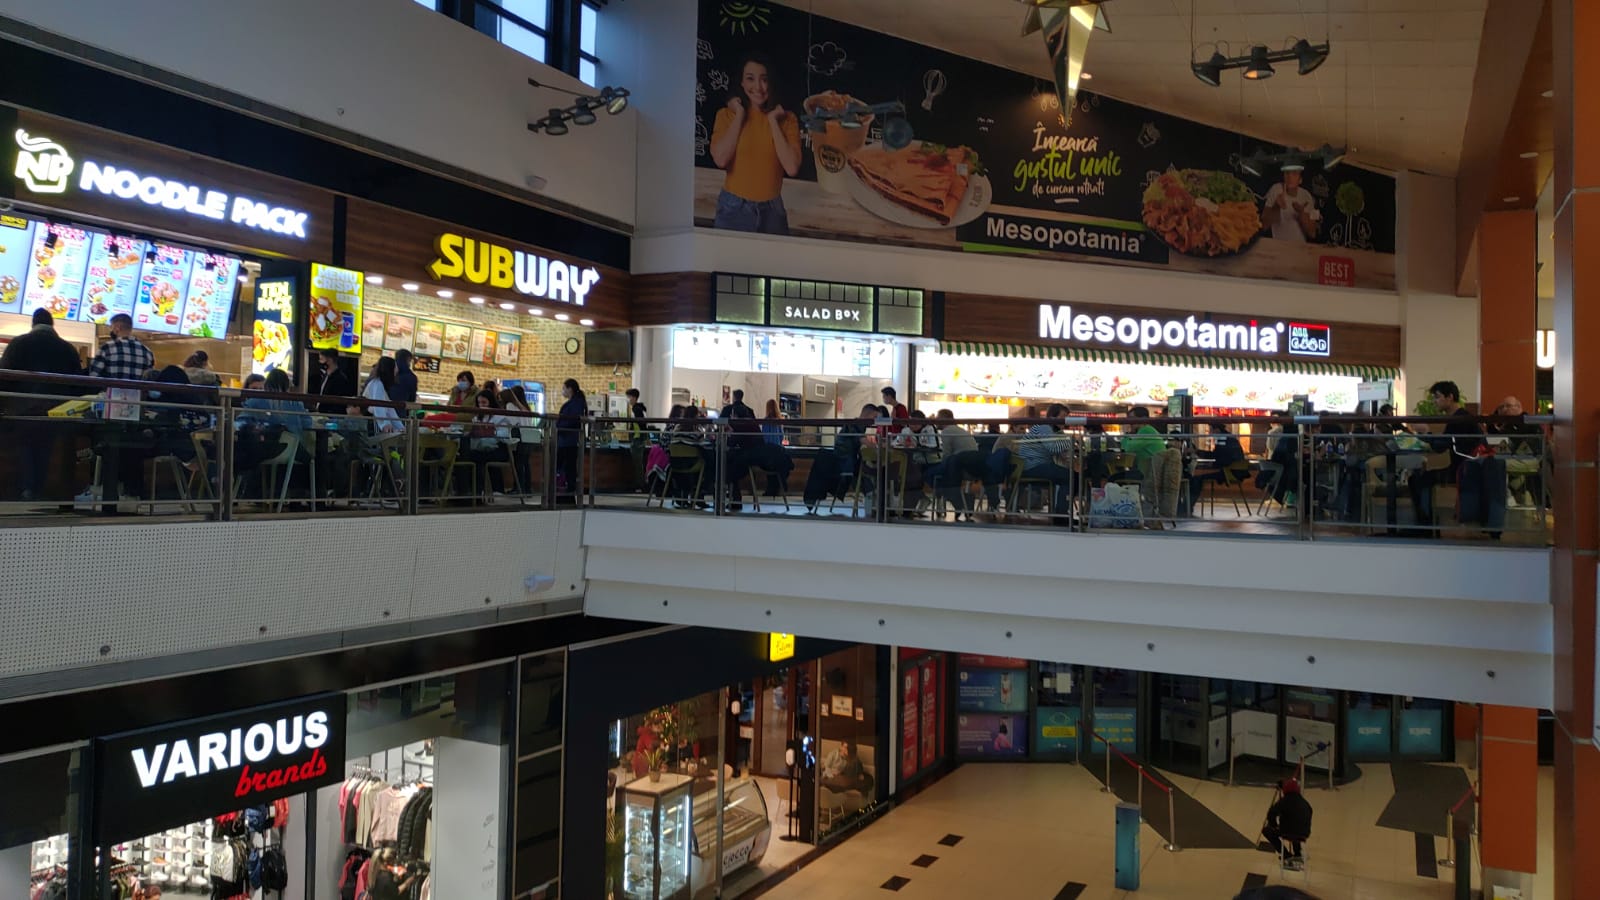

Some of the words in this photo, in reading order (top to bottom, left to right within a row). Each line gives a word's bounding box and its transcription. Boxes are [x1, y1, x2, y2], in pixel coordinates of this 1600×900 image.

[1031, 120, 1099, 153] Încearcă
[15, 150, 74, 182] NP
[1013, 144, 1077, 192] gustul
[1079, 150, 1122, 177] unic
[79, 161, 228, 221] NOODLE
[231, 196, 309, 239] PACK
[1032, 179, 1044, 199] de
[1046, 184, 1074, 195] curcan
[986, 216, 1141, 255] Mesopotamia
[314, 276, 361, 295] CRISPY
[425, 232, 601, 307] SUBWAY
[1324, 261, 1350, 280] BEST
[785, 306, 831, 320] SALAD
[1039, 303, 1279, 353] Mesopotamia
[131, 710, 329, 789] VARIOUS
[235, 749, 328, 799] brands
